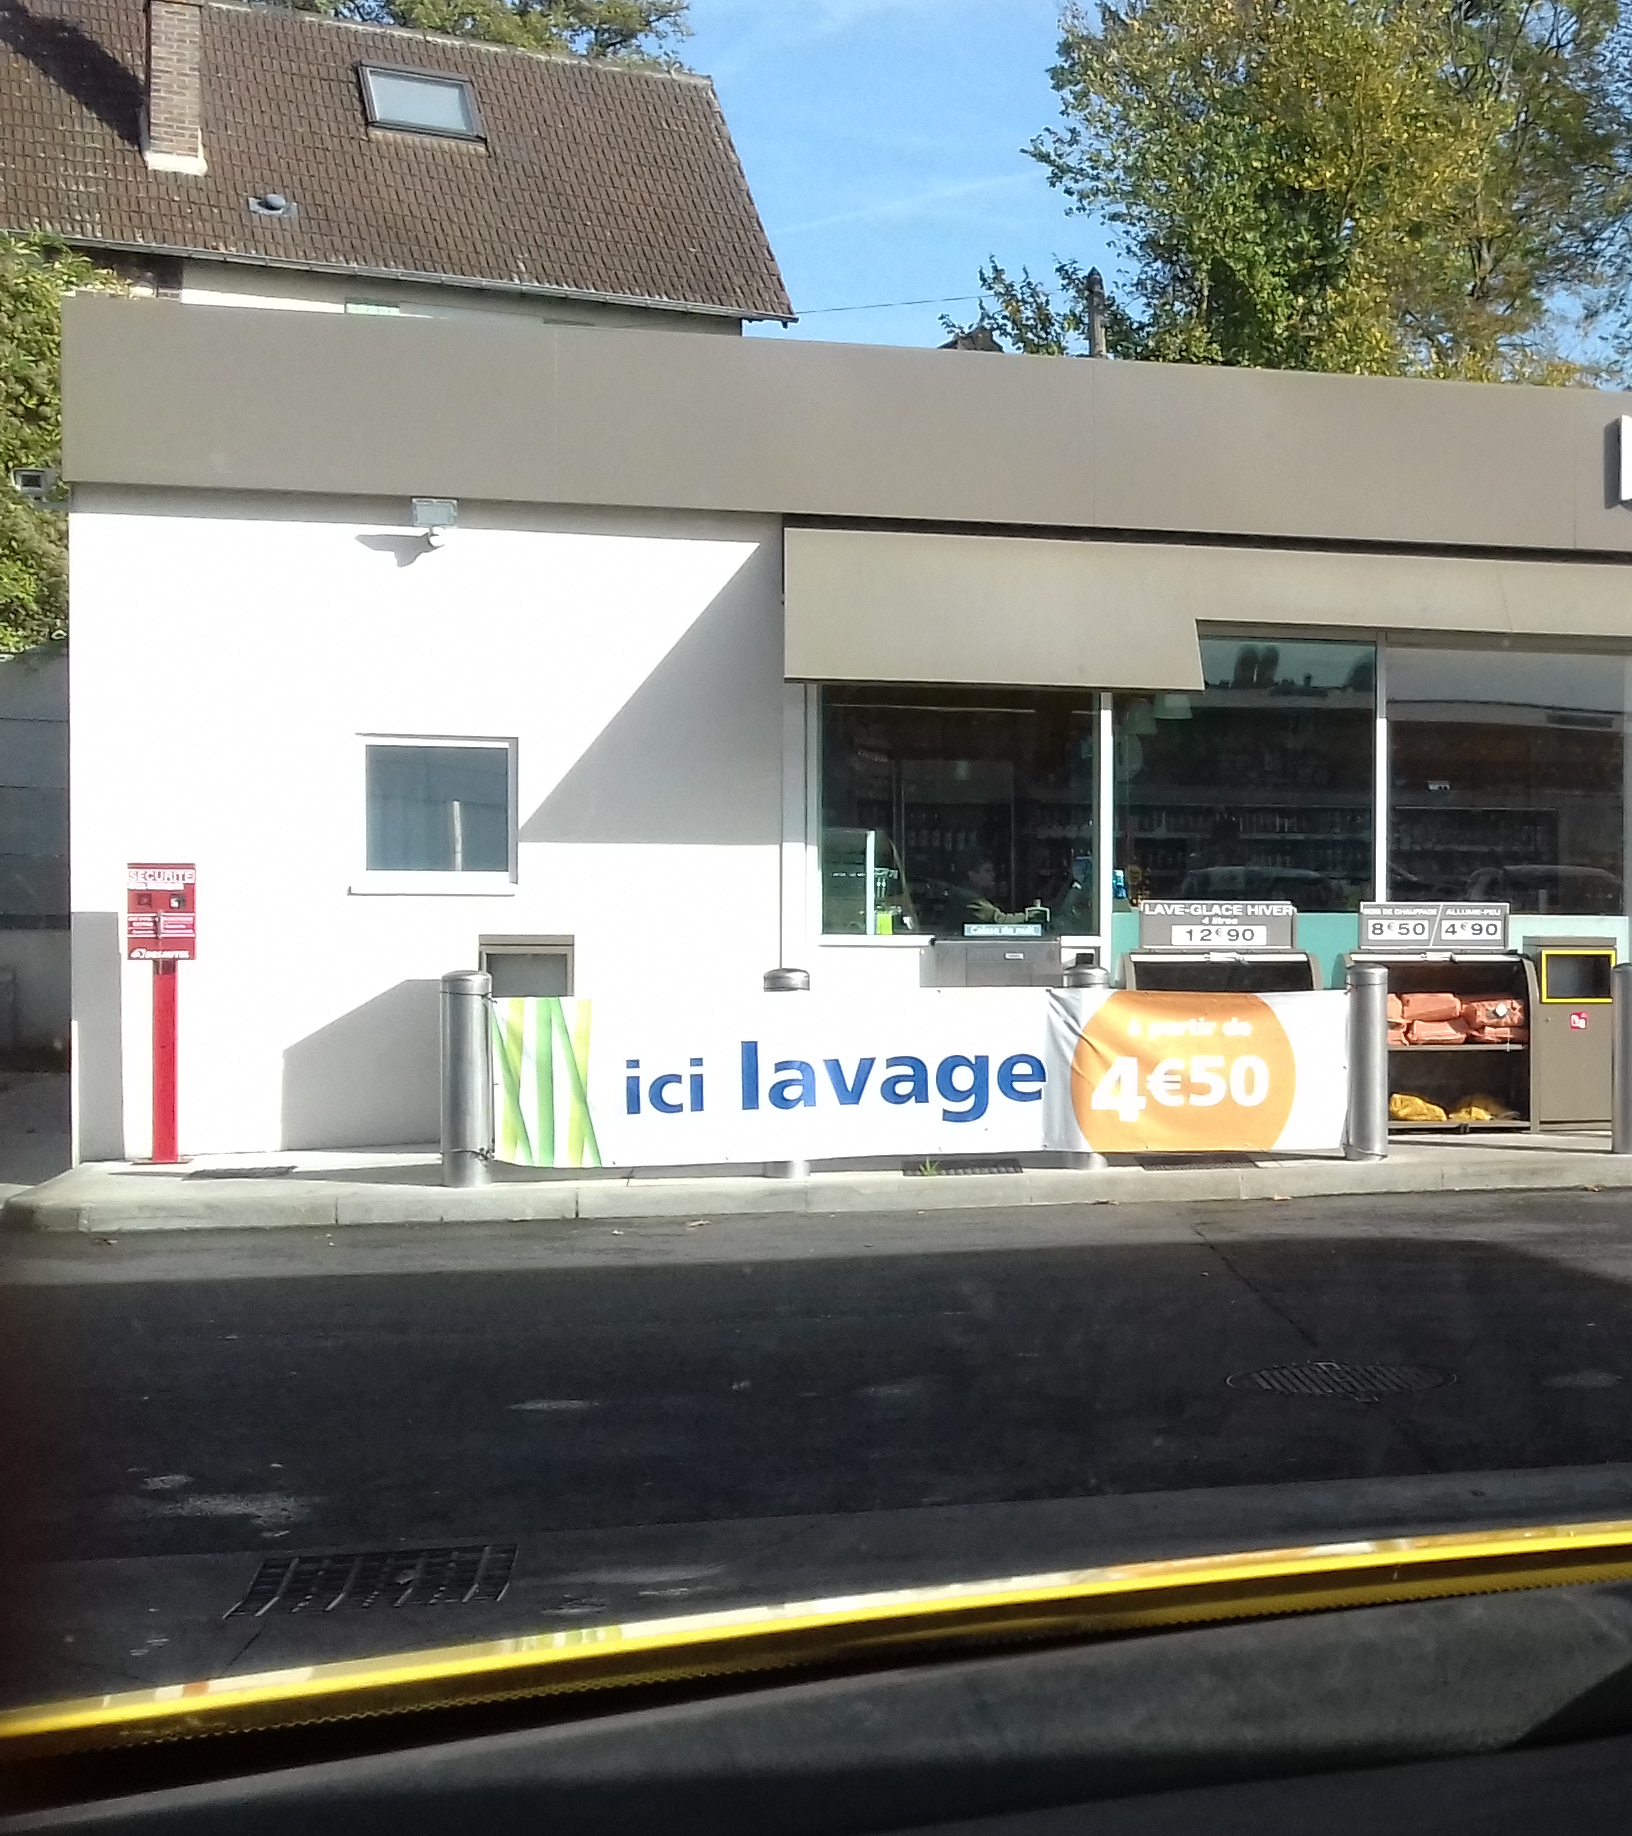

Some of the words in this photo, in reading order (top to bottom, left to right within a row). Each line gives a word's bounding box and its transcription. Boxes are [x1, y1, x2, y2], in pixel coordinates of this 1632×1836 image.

[1144, 903, 1243, 916] LAVE-GLACE
[1247, 903, 1294, 917] HIVER
[1149, 1017, 1217, 1040] partir
[1223, 1017, 1252, 1036] de
[626, 1057, 704, 1115] ici
[740, 1041, 1047, 1123] lavage
[1091, 1055, 1270, 1123] 4€50
